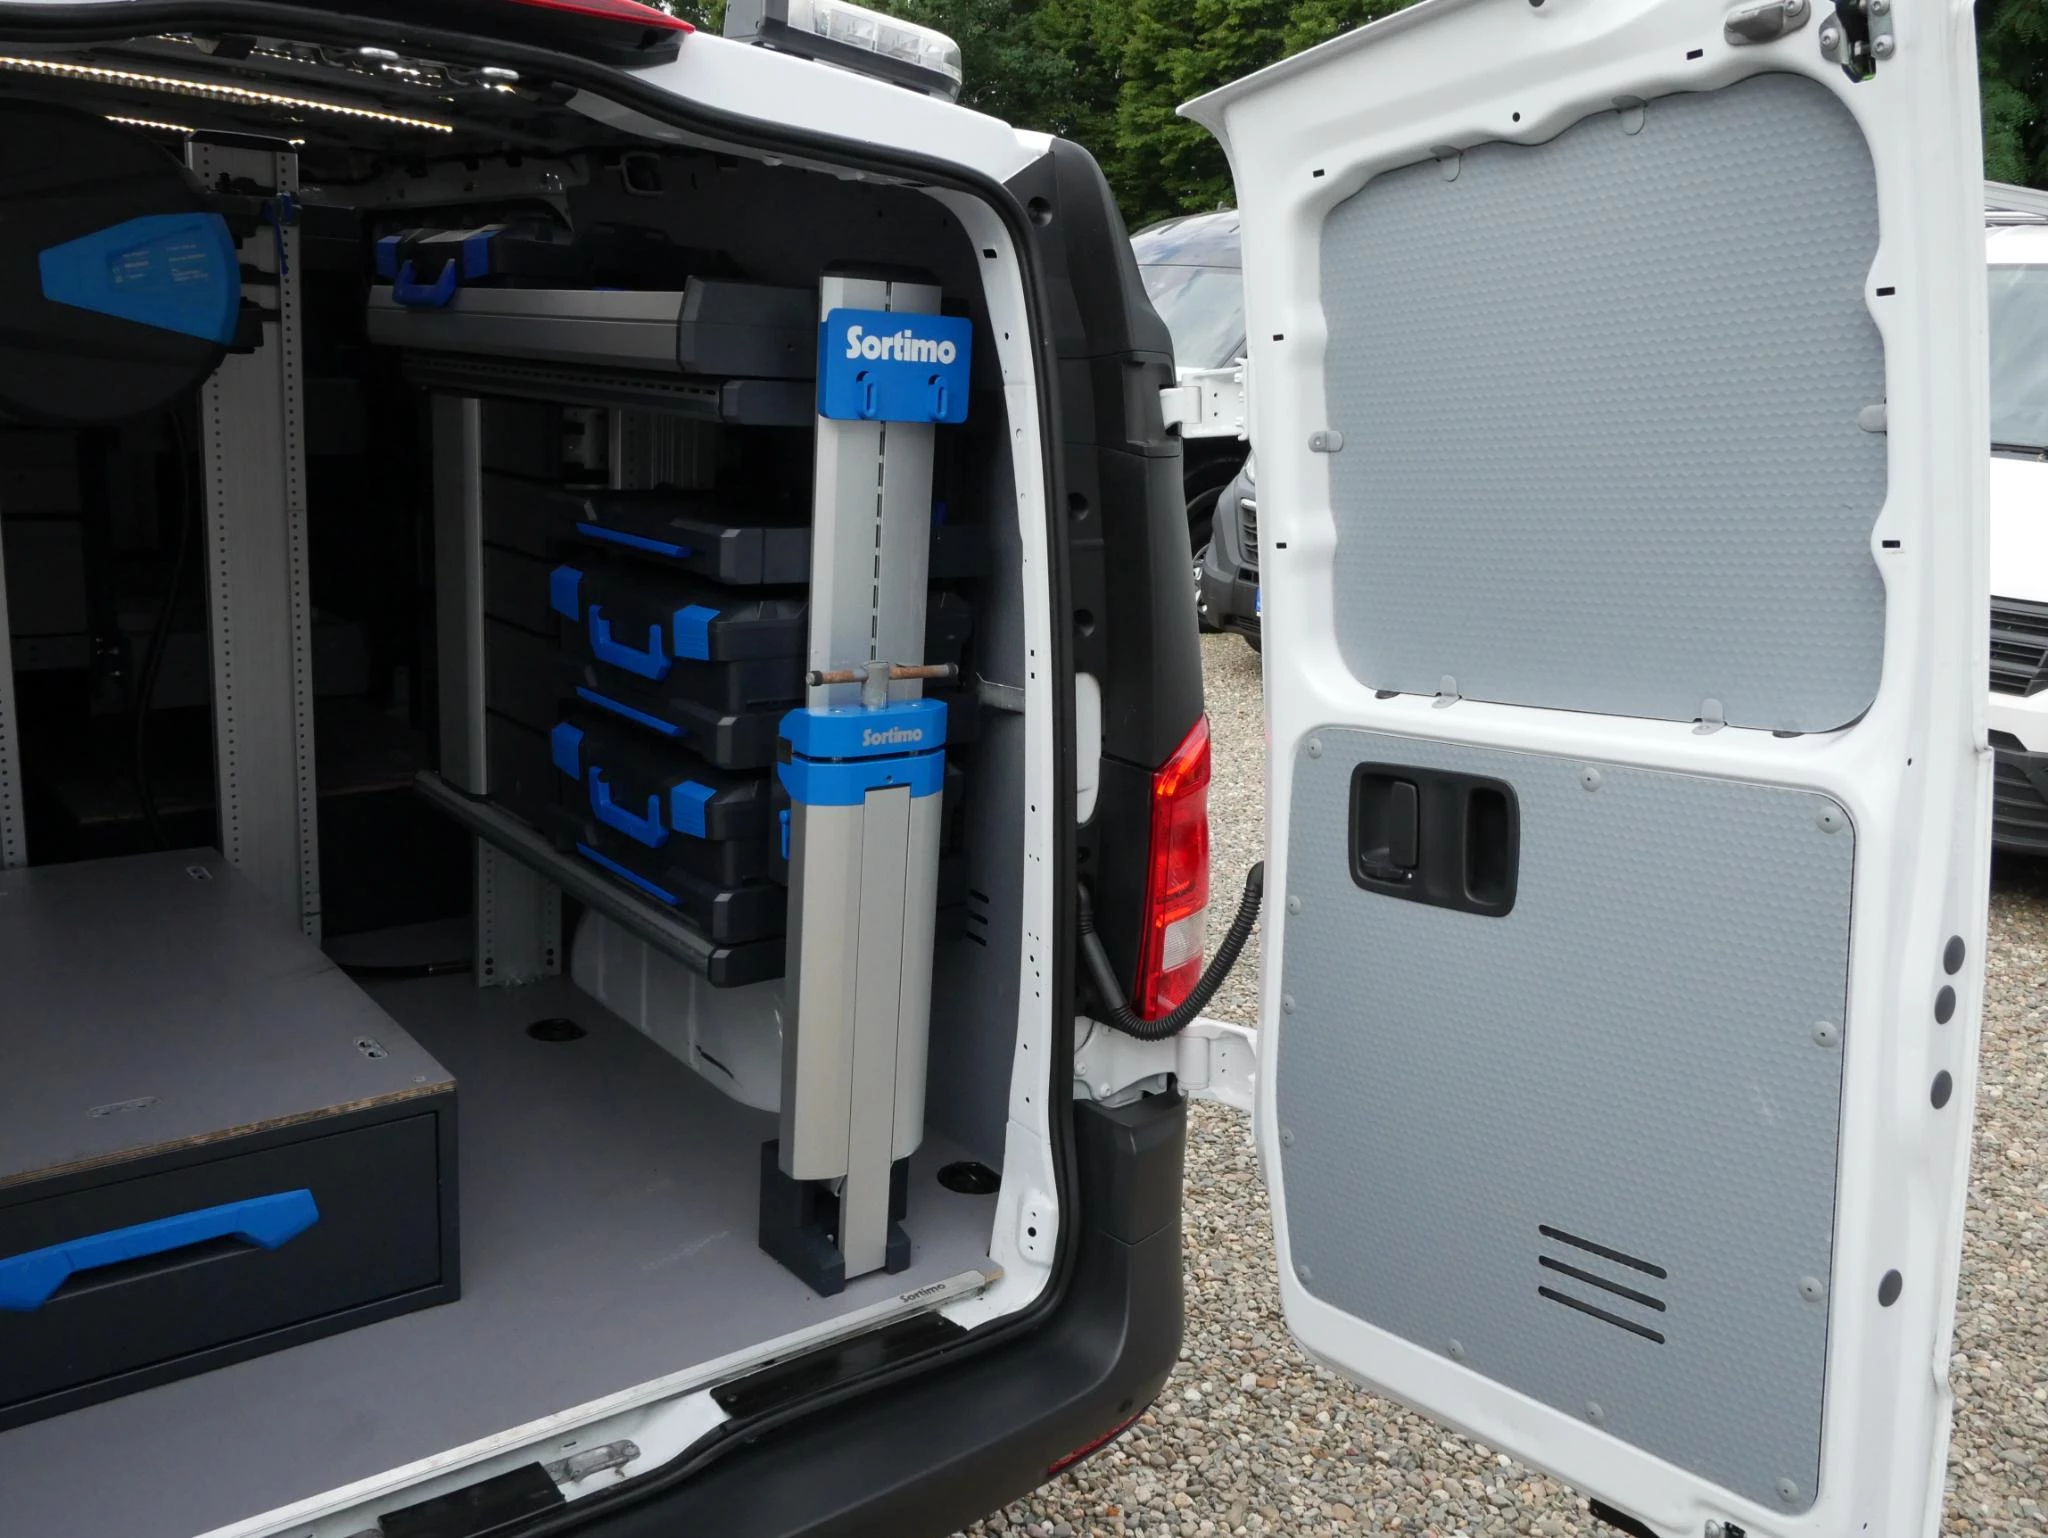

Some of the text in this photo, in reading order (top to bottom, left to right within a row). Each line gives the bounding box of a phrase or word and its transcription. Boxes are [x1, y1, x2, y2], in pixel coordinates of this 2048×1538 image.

[846, 325, 957, 365] Sortimo
[862, 726, 923, 747] Sortimo
[900, 1282, 947, 1303] Sortimo
